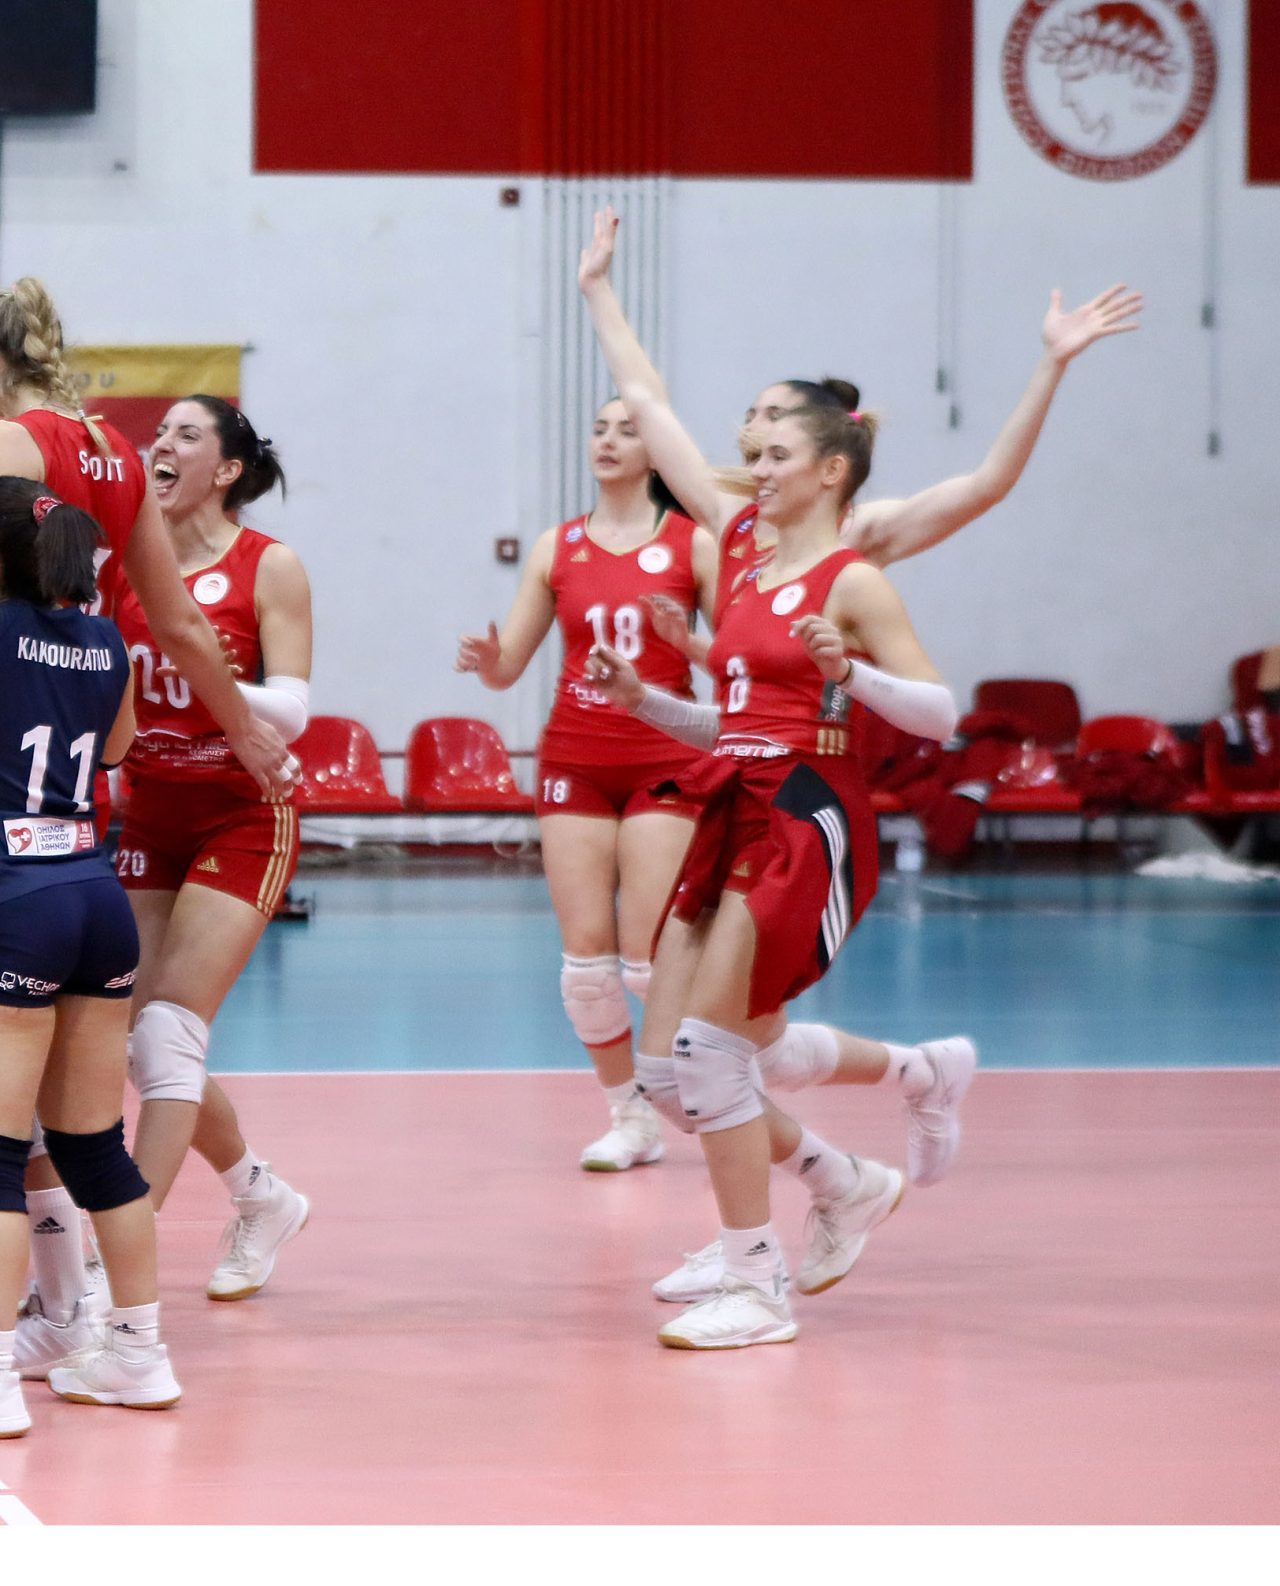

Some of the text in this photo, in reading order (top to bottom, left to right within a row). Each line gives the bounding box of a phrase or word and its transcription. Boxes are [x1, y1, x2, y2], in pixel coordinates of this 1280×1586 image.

[585, 604, 640, 661] 18
[21, 725, 96, 814] 11
[543, 779, 568, 804] 18
[117, 849, 146, 877] 20
